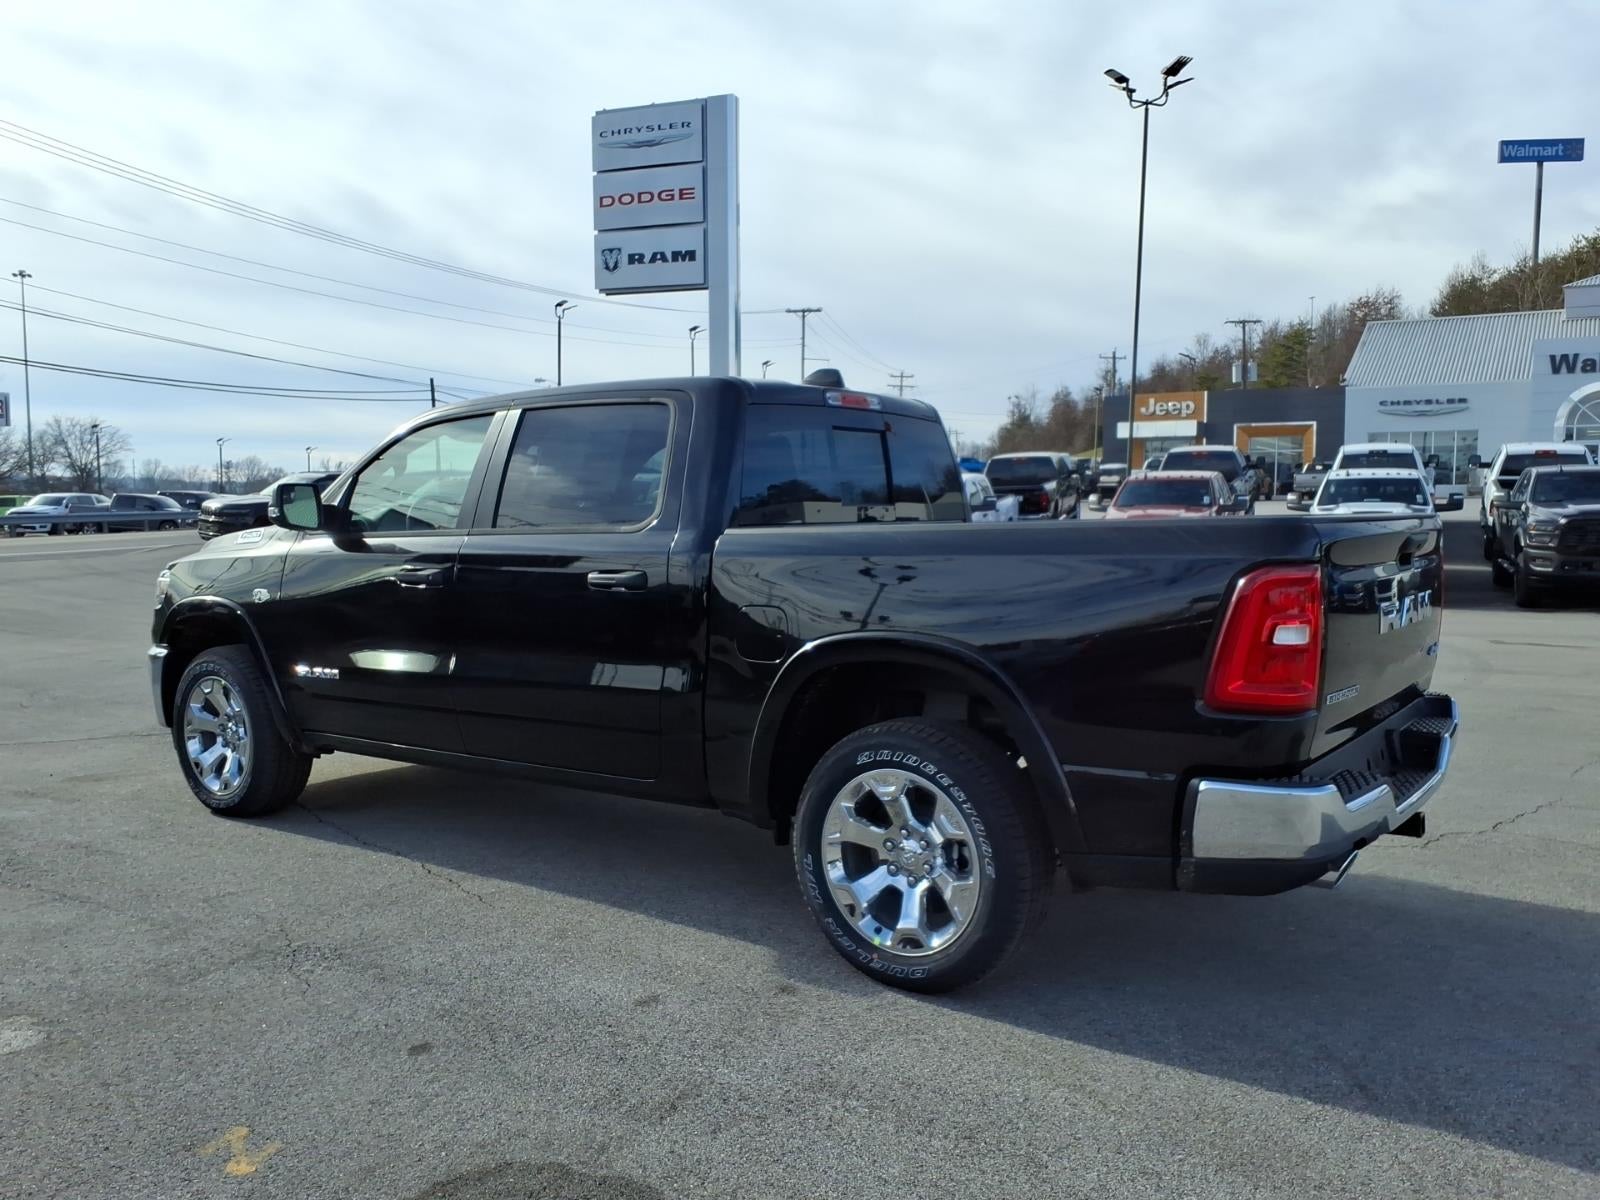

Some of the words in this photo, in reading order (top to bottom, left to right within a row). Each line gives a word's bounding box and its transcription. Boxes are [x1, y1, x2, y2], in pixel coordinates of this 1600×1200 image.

[599, 121, 692, 138] CHRYSLER
[1503, 143, 1564, 157] Walmart
[599, 187, 695, 208] DODGE
[627, 249, 697, 266] RAM
[1549, 353, 1600, 375] Wa
[1140, 397, 1196, 418] Jeep
[1379, 397, 1468, 407] CHRYSLER
[1378, 589, 1433, 635] RAM
[856, 749, 996, 879] BRIDGESTONE
